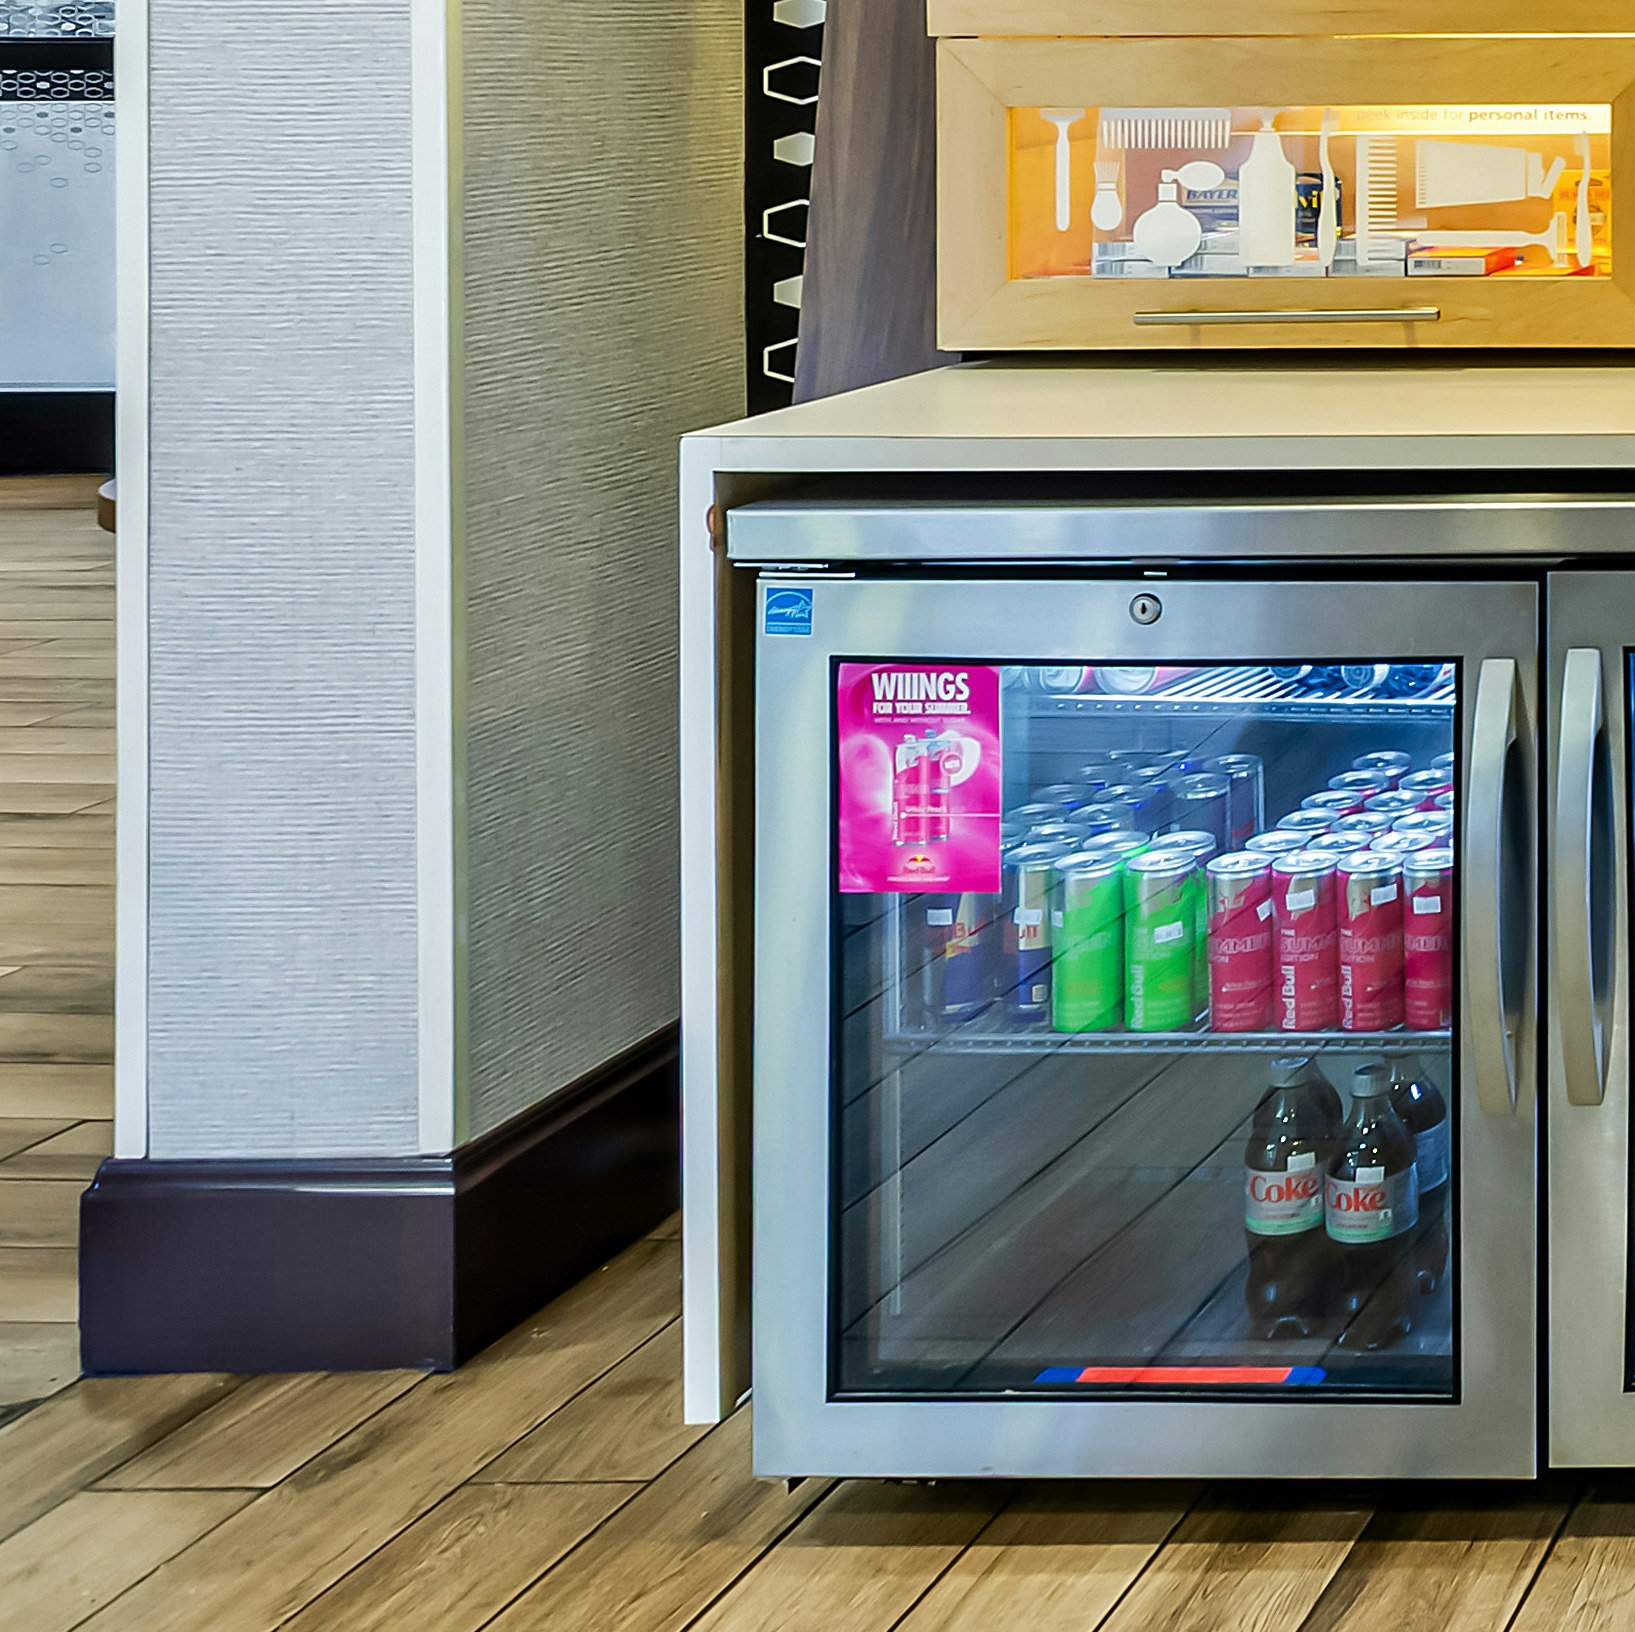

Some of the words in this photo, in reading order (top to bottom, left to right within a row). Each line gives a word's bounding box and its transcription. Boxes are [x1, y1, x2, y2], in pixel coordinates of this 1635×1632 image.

[1443, 108, 1465, 121] for
[1469, 108, 1538, 123] personal
[1544, 108, 1592, 121] items.
[1186, 189, 1239, 201] BAYER
[872, 672, 970, 701] WIIINGS
[1250, 1174, 1319, 1204] Coke
[1326, 1181, 1387, 1213] Coke
